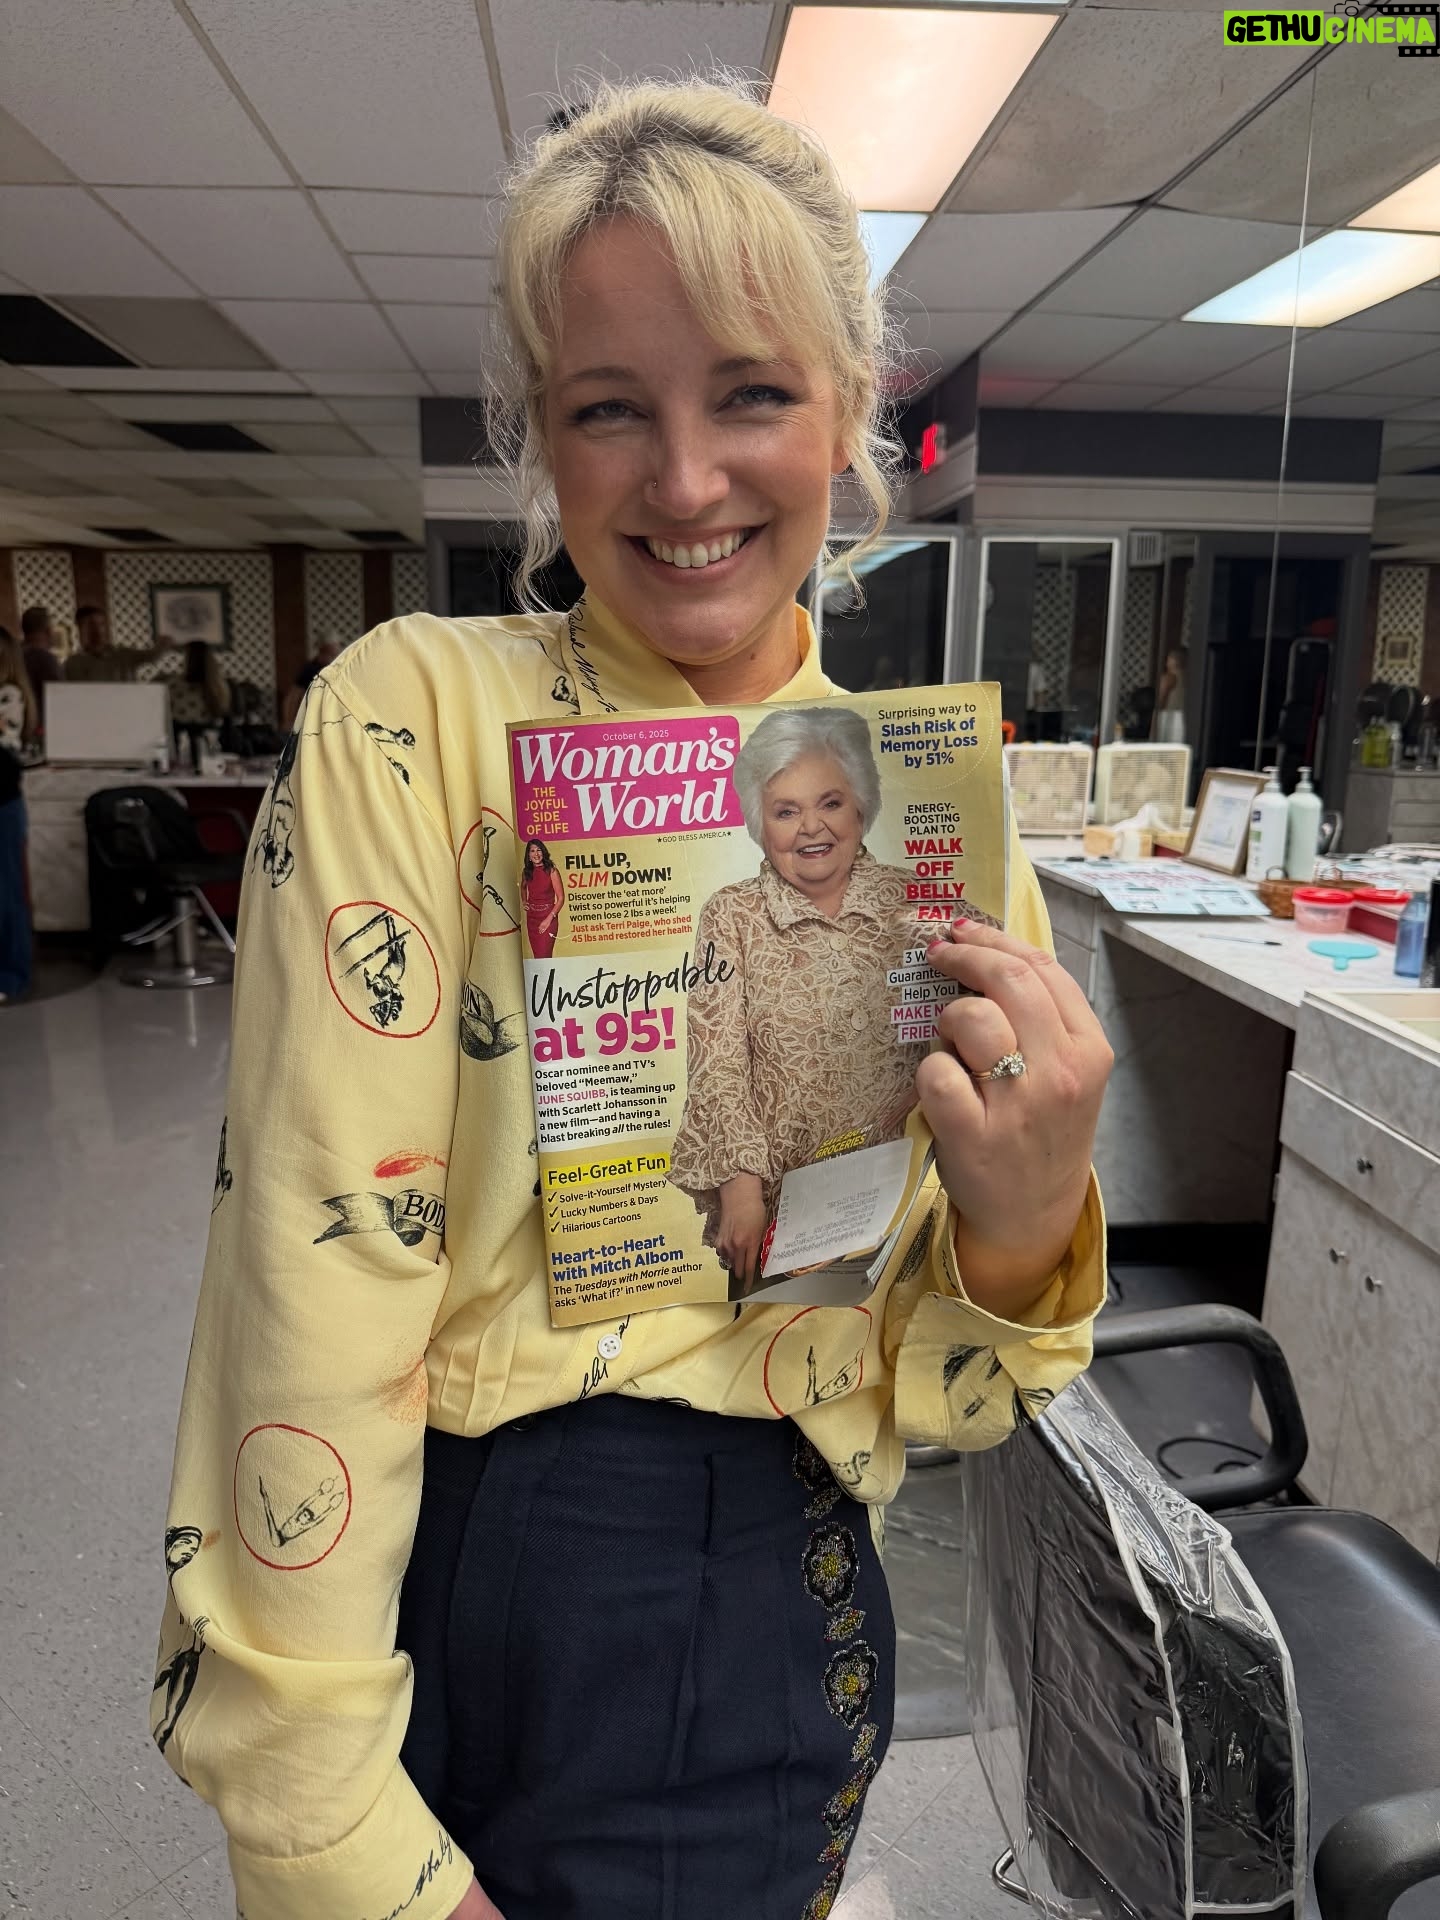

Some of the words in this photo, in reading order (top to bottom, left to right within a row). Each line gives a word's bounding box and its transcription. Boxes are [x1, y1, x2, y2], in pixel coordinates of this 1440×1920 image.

[878, 706, 936, 720] Surprising
[938, 705, 961, 714] way
[964, 703, 976, 712] to
[882, 720, 920, 736] Slash
[924, 719, 956, 734] Risk
[960, 717, 976, 730] of
[603, 731, 637, 741] October
[639, 731, 647, 740] 6,
[649, 730, 669, 738] 2025
[880, 738, 940, 753] Memory
[944, 735, 978, 748] Loss
[516, 727, 736, 784] Woman's
[904, 754, 922, 768] by
[926, 751, 954, 766] 51%
[533, 787, 556, 798] THE
[524, 799, 568, 811] JOYFUL
[573, 778, 728, 832] World
[908, 802, 955, 814] ENERGY-
[533, 811, 560, 822] SIDE
[904, 813, 960, 824] BOOSTING
[527, 824, 543, 835] OF
[544, 823, 569, 834] LIFE
[679, 834, 697, 842] BLESS
[699, 832, 726, 840] AMERICA
[910, 826, 938, 835] PLAN
[940, 824, 955, 833] TO
[904, 838, 963, 856] WALK
[565, 855, 600, 870] FILL
[604, 853, 630, 868] UP,
[916, 861, 954, 877] OFF
[567, 871, 608, 888] SLIM
[613, 867, 672, 885] DOWN!
[568, 892, 605, 902] Discover
[607, 890, 622, 899] the
[906, 882, 965, 900] BELLY
[569, 902, 591, 911] twist
[605, 899, 643, 911] powerful
[659, 895, 690, 907] helping
[570, 914, 602, 922] women
[604, 911, 621, 920] lose
[624, 910, 630, 918] 2
[631, 909, 644, 917] lbs
[652, 906, 677, 915] week!
[918, 906, 954, 920] FAT
[571, 924, 588, 932] Just
[590, 923, 604, 931] ask
[606, 922, 625, 930] Terri
[627, 920, 652, 930] Paige,
[654, 918, 670, 926] who
[672, 915, 692, 924] shed
[585, 934, 596, 942] lbs
[598, 932, 614, 940] and
[616, 929, 651, 940] restored
[652, 928, 666, 936] her
[667, 926, 692, 935] health
[906, 952, 912, 964] 3
[531, 941, 735, 1022] Unstoppable
[904, 987, 930, 1000] Help
[933, 984, 955, 996] You
[894, 1005, 931, 1021] MAKE
[534, 1018, 585, 1062] at
[596, 1007, 676, 1056] 95!
[902, 1025, 940, 1040] FRIEN
[535, 1070, 564, 1080] Oscar
[566, 1064, 610, 1076] nominee
[612, 1061, 631, 1070] and
[536, 1080, 576, 1092] beloved
[538, 1094, 564, 1104] JUNE
[567, 1088, 608, 1102] SQUIBB,
[610, 1088, 618, 1096] is
[620, 1085, 661, 1096] teaming
[663, 1083, 676, 1092] up
[538, 1108, 560, 1118] with
[562, 1103, 601, 1116] Scarlett
[603, 1097, 656, 1110] Johansson
[658, 1096, 667, 1104] in
[548, 1120, 568, 1130] new
[619, 1110, 652, 1121] having
[540, 1133, 566, 1143] blast
[567, 1127, 610, 1140] breaking
[612, 1124, 624, 1134] all
[626, 1123, 642, 1132] the
[644, 1120, 670, 1130] rules!
[816, 1135, 866, 1158] GROCERIES
[548, 1160, 632, 1186] Feel-Great
[637, 1157, 666, 1172] Fun
[560, 1183, 631, 1203] Solve-it-Yourself
[633, 1180, 667, 1191] Mystery
[561, 1206, 586, 1218] Lucky
[589, 1199, 628, 1213] Numbers
[630, 1198, 636, 1206] &
[638, 1195, 658, 1206] Days
[562, 1220, 601, 1233] Hilarious
[602, 1212, 641, 1226] Cartoons
[552, 1234, 666, 1265] Heart-to-Heart
[553, 1266, 588, 1282] with
[591, 1257, 631, 1276] Mitch
[634, 1250, 684, 1267] Albom
[554, 1286, 572, 1296] The
[574, 1278, 617, 1292] Tuesdays
[619, 1273, 638, 1284] with
[640, 1266, 670, 1280] Morrie
[672, 1262, 702, 1274] author
[555, 1298, 576, 1308] asks
[625, 1286, 634, 1294] in
[636, 1282, 656, 1292] new
[657, 1276, 682, 1288] novel
